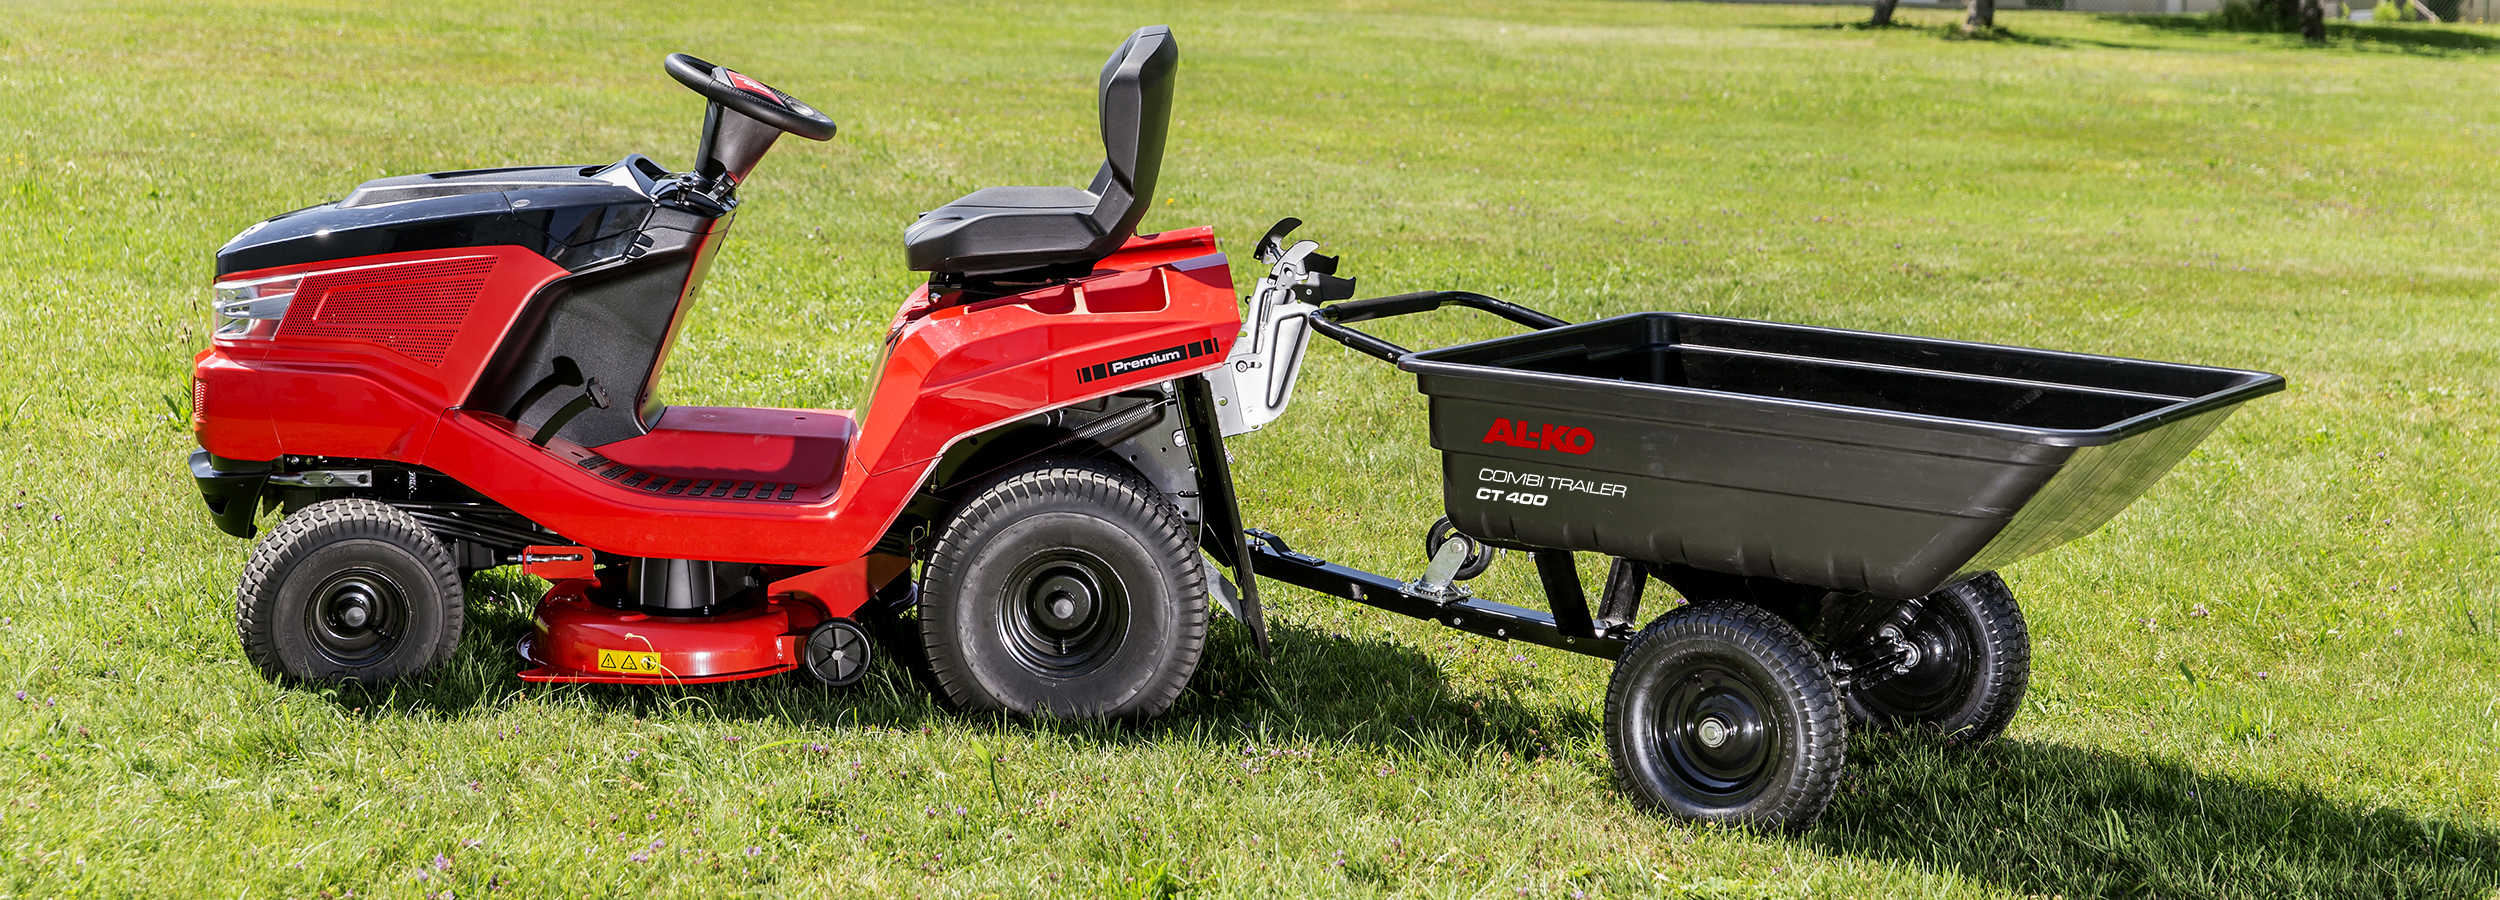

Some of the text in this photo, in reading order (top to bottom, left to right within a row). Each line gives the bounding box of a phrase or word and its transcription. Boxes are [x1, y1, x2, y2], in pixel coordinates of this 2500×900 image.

[1111, 350, 1181, 374] Premium
[1481, 417, 1596, 455] AL-KO
[1475, 487, 1549, 507] CT 400
[1478, 467, 1628, 499] COMBI TRAILER
